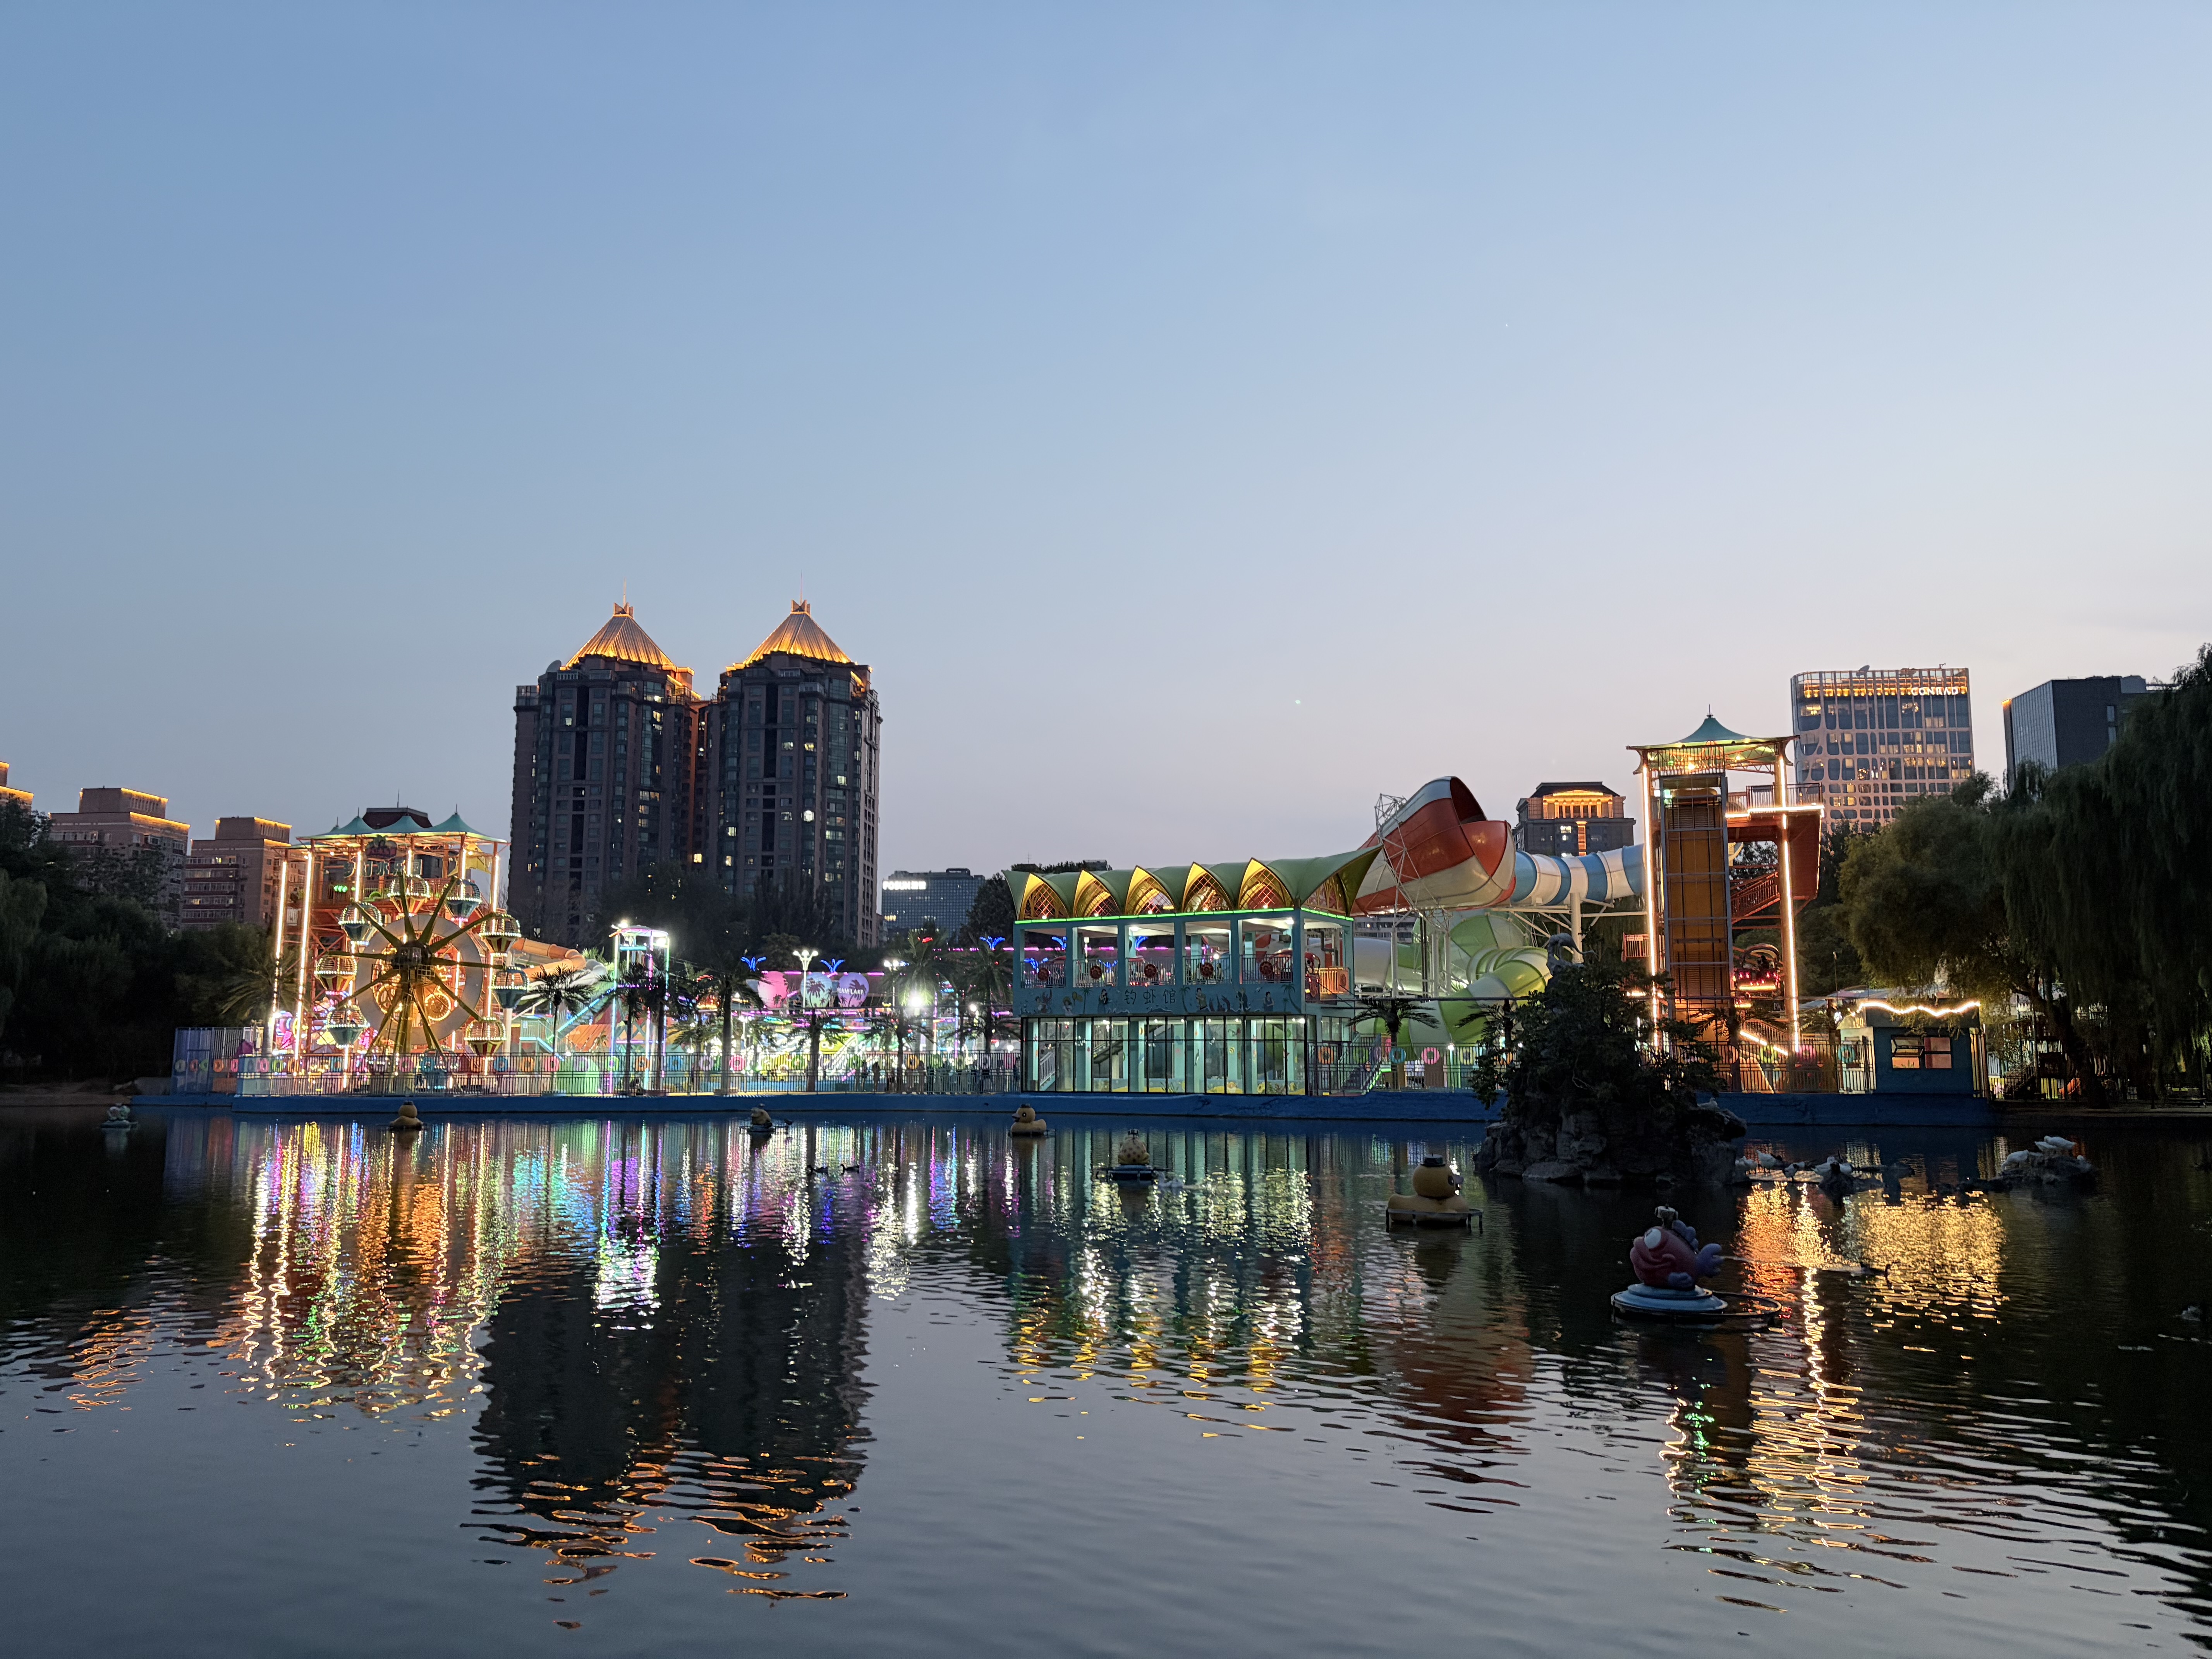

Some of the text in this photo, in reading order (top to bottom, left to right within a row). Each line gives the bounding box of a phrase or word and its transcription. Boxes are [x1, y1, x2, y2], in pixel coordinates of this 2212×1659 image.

[1911, 687, 1959, 696] CONRAD
[1124, 988, 1176, 1005] 钓虾馆
